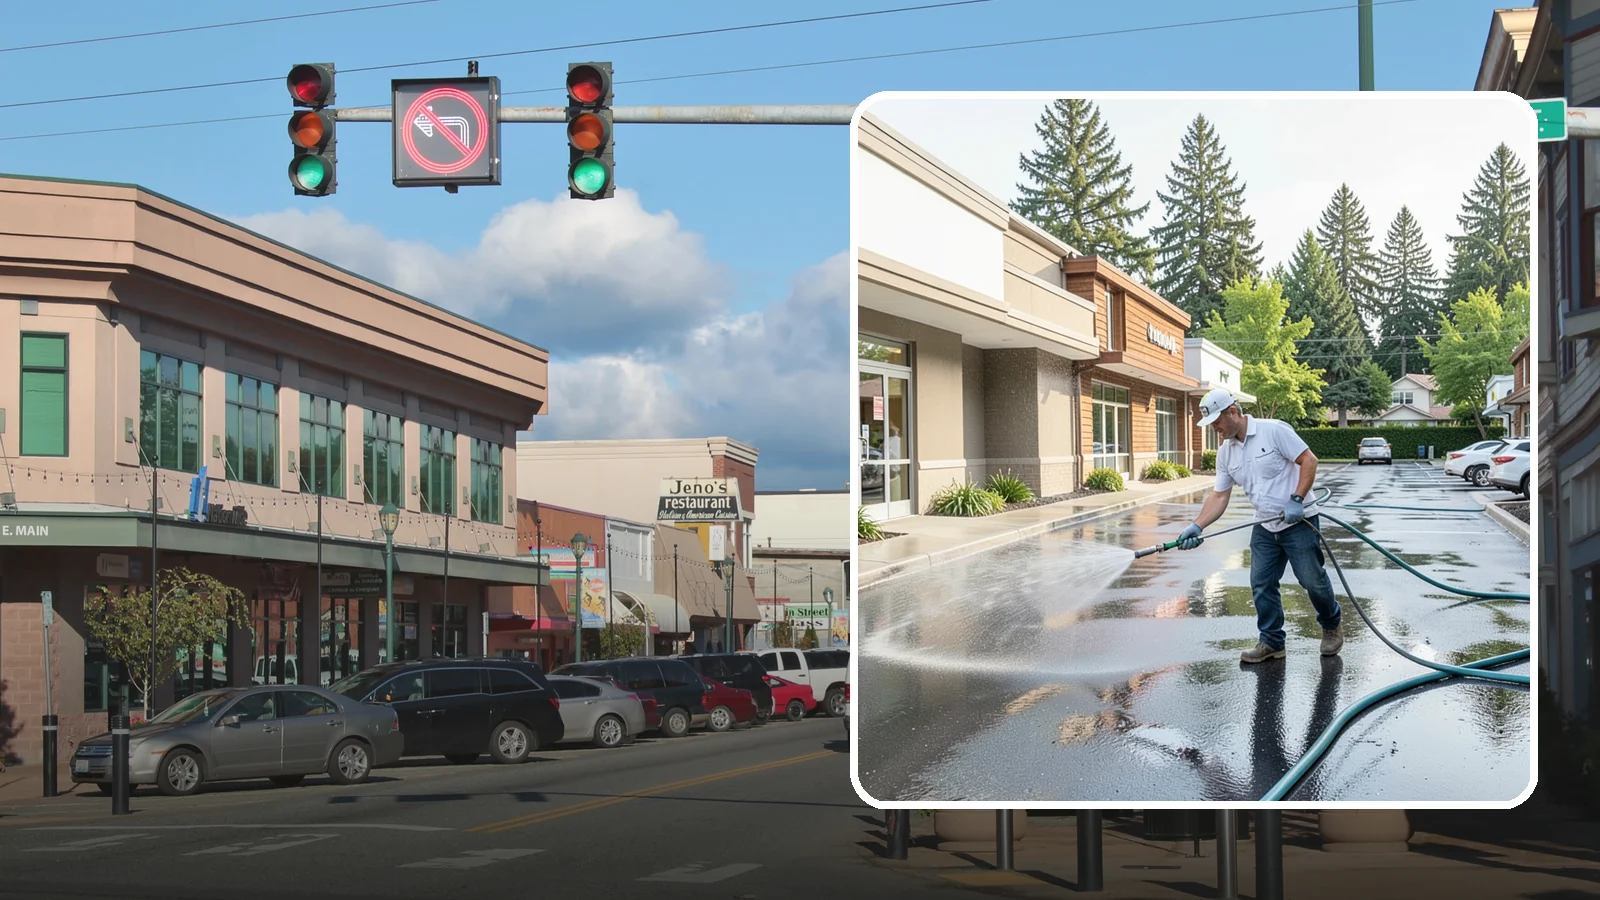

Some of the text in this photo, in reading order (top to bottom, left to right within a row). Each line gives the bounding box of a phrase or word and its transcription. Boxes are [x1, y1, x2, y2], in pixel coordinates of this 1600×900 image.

[670, 480, 728, 494] Jeno's
[665, 496, 731, 509] restaurant
[659, 510, 681, 519] Italian
[686, 510, 714, 519] American
[715, 509, 737, 519] Cuisine
[2, 525, 49, 536] E. MAIN
[797, 607, 829, 617] Street
